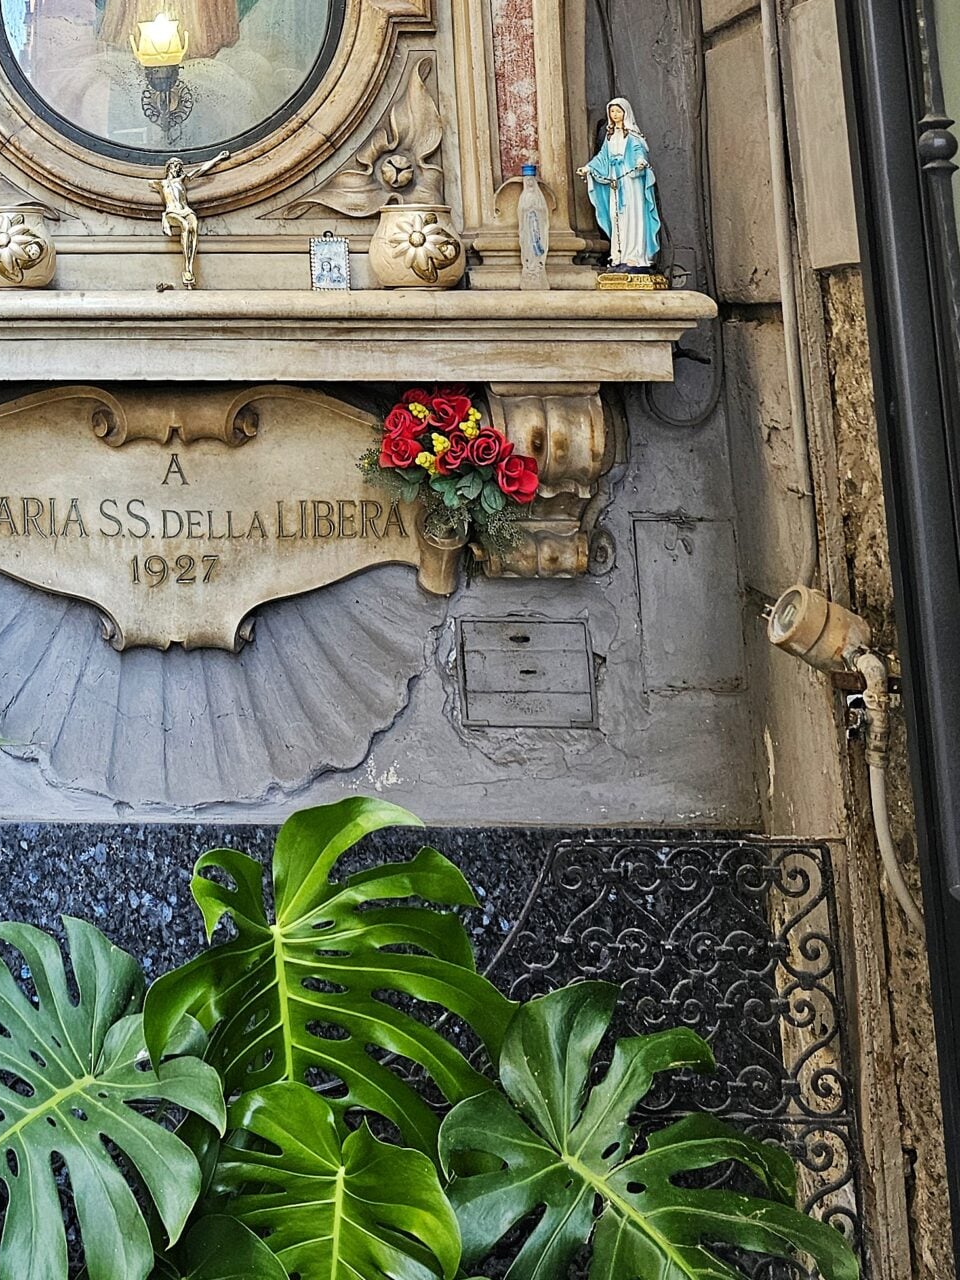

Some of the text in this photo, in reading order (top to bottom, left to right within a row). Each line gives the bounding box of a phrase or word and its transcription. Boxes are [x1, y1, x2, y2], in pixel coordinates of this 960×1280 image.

[161, 453, 190, 486] A
[99, 498, 156, 539] S.S.
[160, 508, 269, 540] DELLA
[276, 499, 410, 540] LIBERA
[130, 554, 220, 589] 1927
